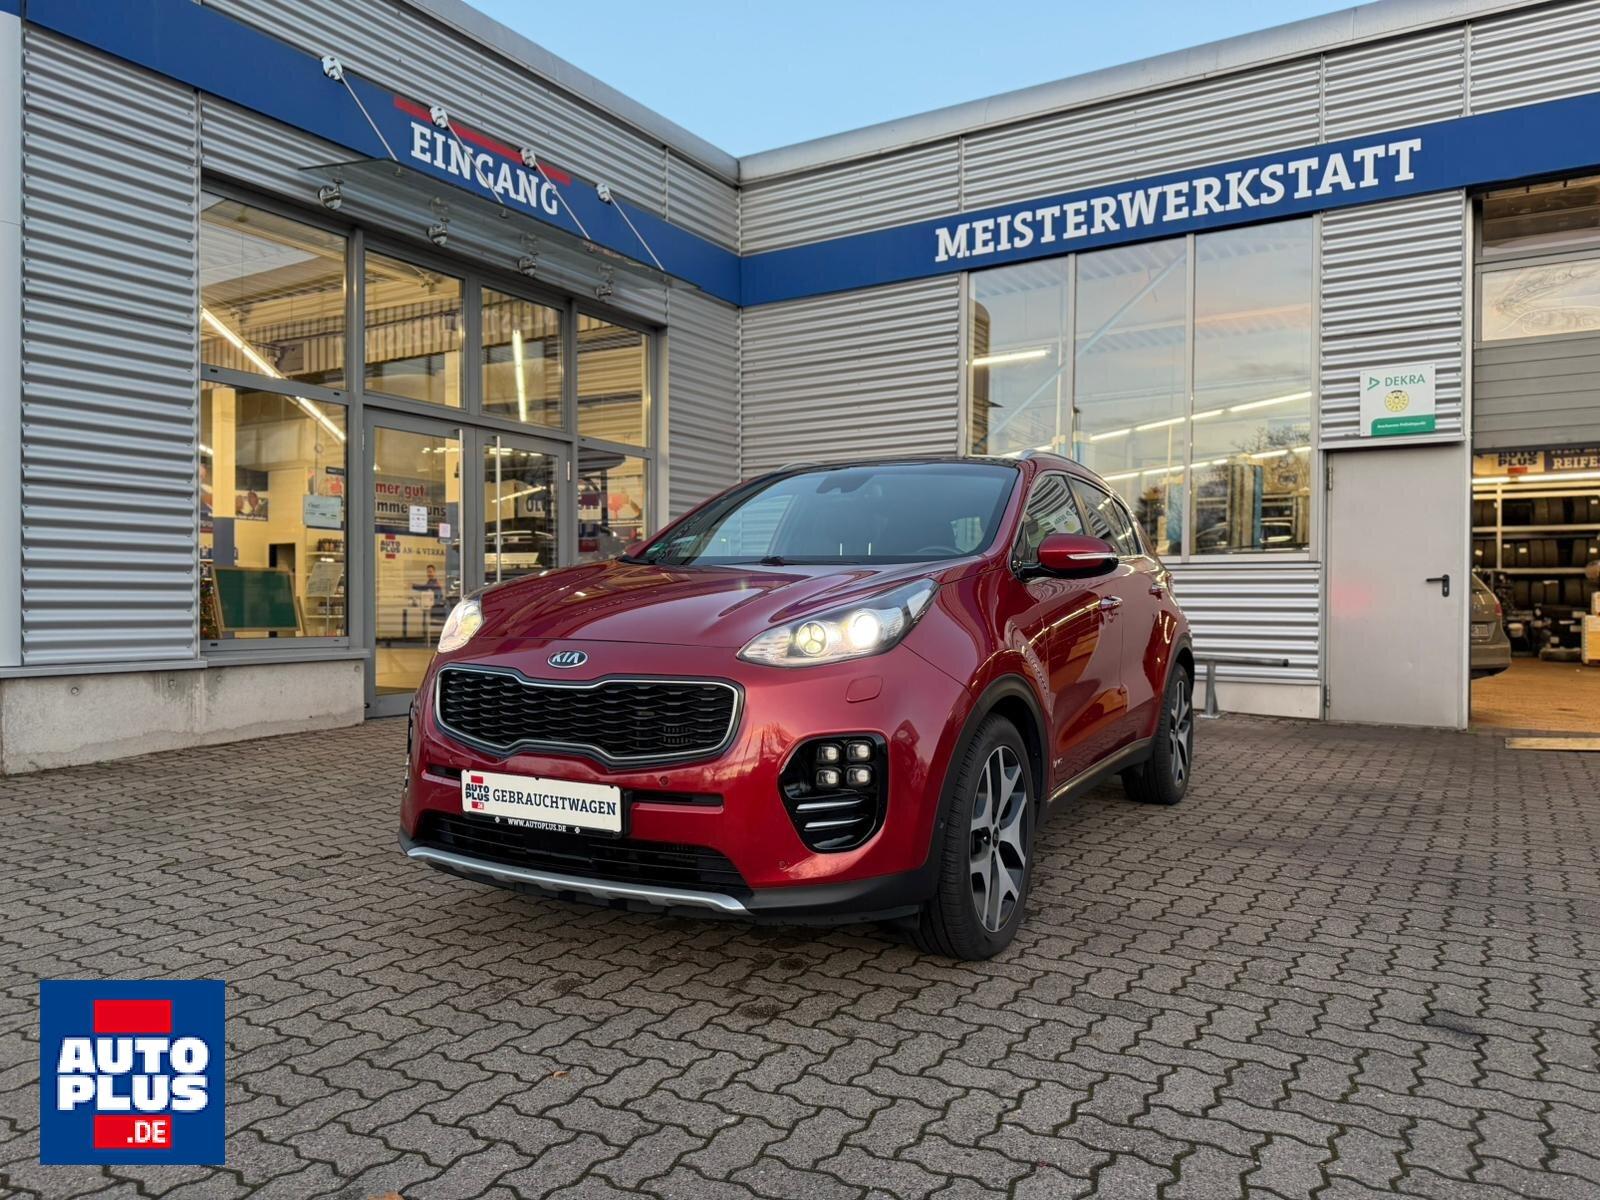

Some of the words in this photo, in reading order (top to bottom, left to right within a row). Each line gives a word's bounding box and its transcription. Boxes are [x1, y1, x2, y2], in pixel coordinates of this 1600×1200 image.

[410, 121, 559, 215] EINGANG
[934, 138, 1422, 262] MEISTERWERKSTATT
[1384, 374, 1426, 387] DEKRA
[1498, 457, 1538, 467] PLUS
[1552, 455, 1600, 469] REIFE
[375, 482, 401, 494] mer
[404, 485, 425, 499] gut
[380, 540, 401, 548] AUTO
[551, 651, 580, 664] KIA
[465, 783, 490, 793] AUTO
[465, 791, 490, 802] PLUS
[492, 788, 617, 816] GEBRAUCHTWAGEN
[507, 818, 567, 832] WWW.AUTOPLUS.DE
